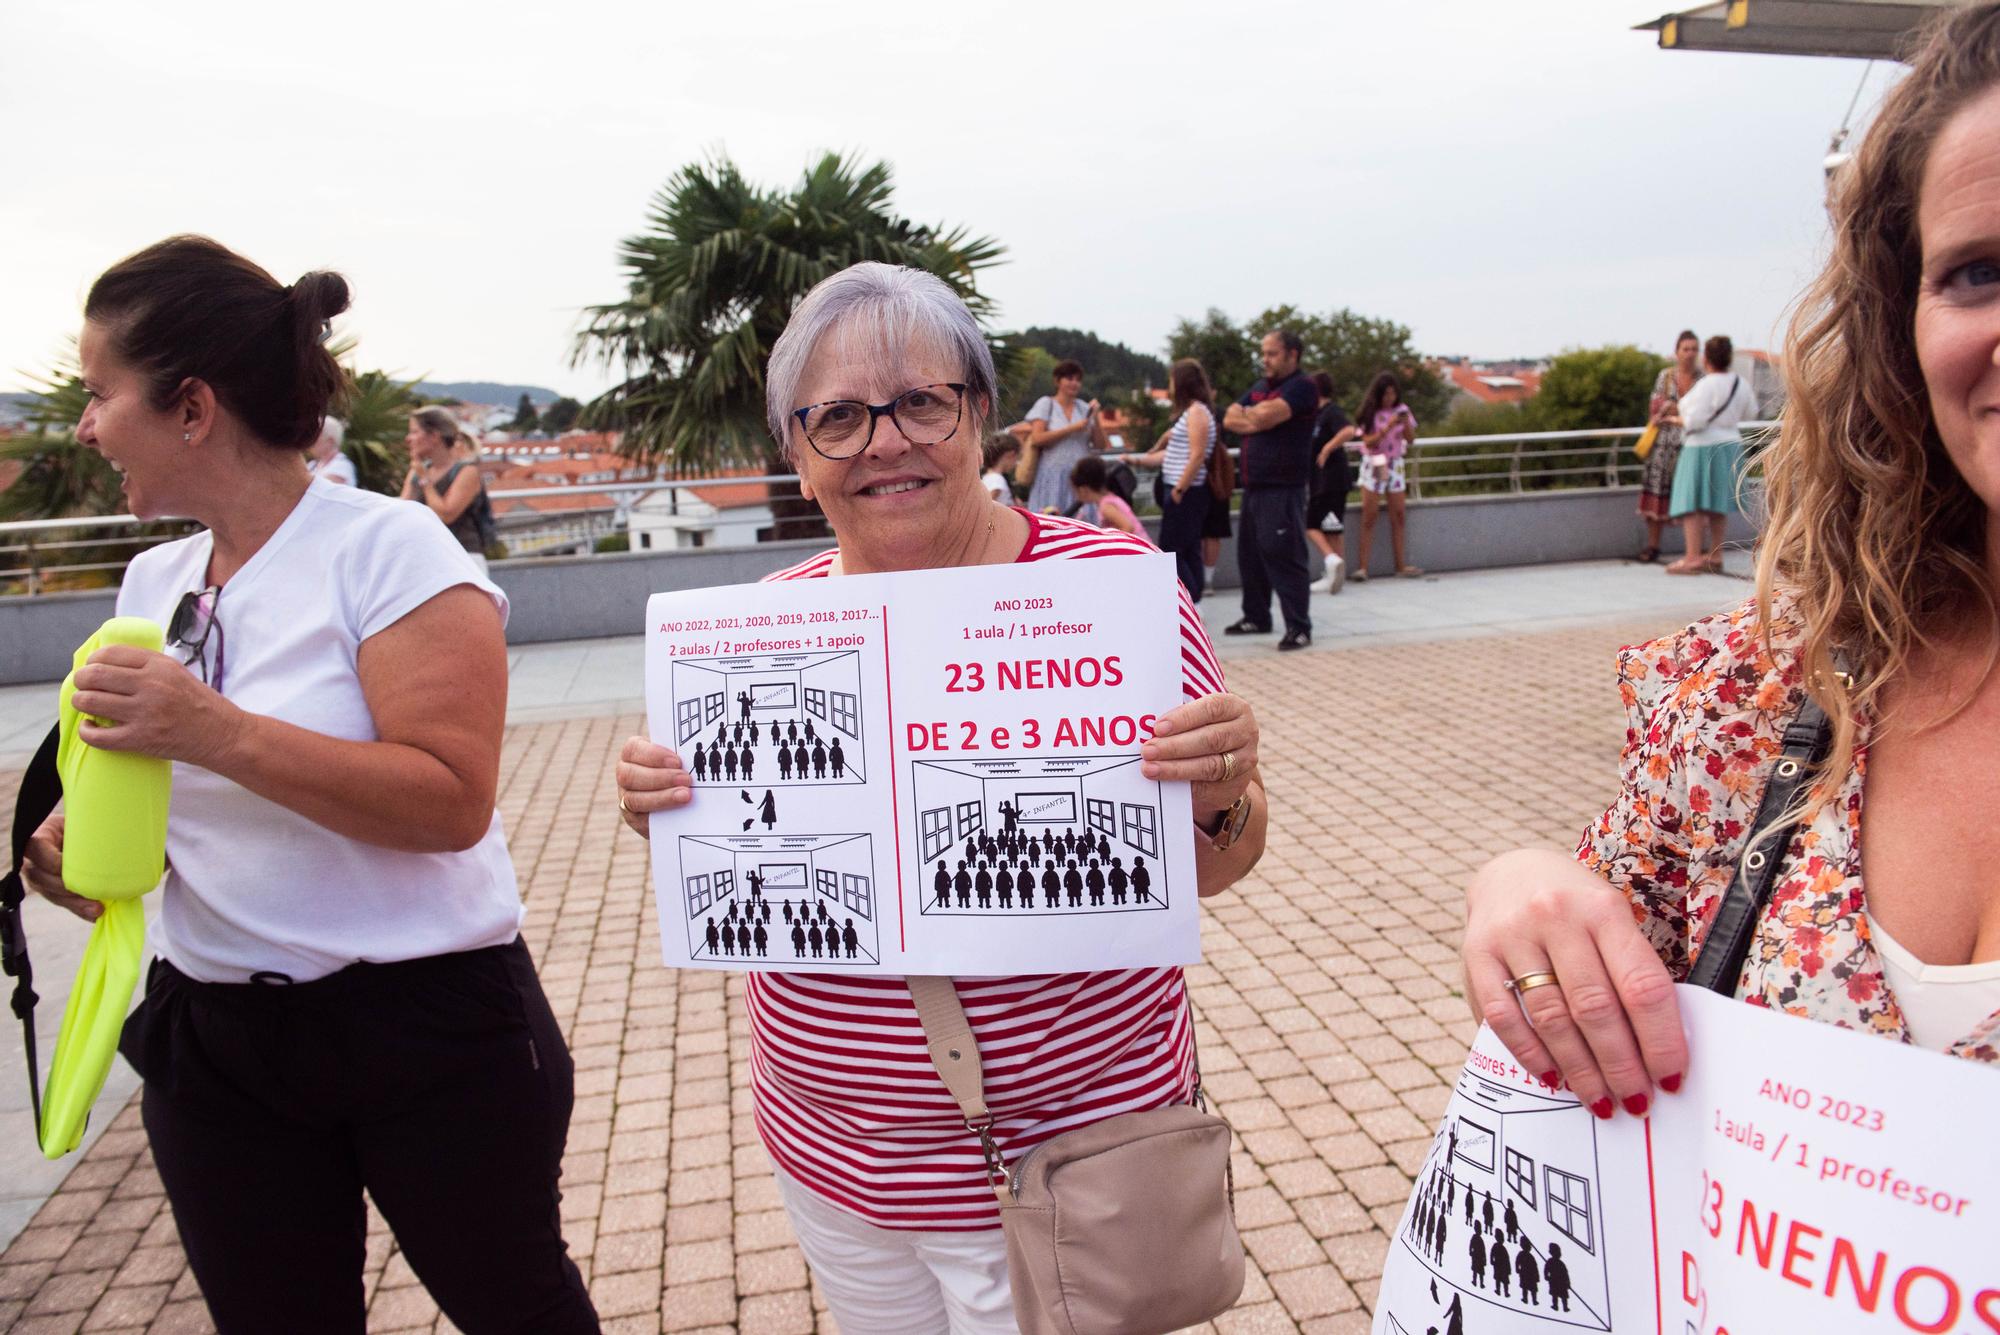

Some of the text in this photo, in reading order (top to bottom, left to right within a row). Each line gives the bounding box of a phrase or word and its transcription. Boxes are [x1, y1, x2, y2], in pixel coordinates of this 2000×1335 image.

[993, 597, 1053, 612] ANO 2023
[660, 622, 682, 633] ANO
[685, 620, 712, 632] 2022,
[715, 618, 742, 630] 2021,
[745, 615, 773, 628] 2020,
[777, 613, 806, 626] 2019,
[809, 611, 838, 624] 2018,
[962, 620, 1093, 639] 1 aula / 1 profesor
[669, 633, 865, 656] 2 aulas / 2 profesores + 1 apoio
[945, 655, 1123, 693] 23 NENOS
[906, 714, 1157, 751] DE 2 e 3 ANOS
[1032, 796, 1067, 815] INFANTIL
[1759, 1078, 1887, 1132] ANO 2023
[1714, 1109, 1972, 1217] 1 aula / 1 profesor
[1736, 1199, 2000, 1335] NENO
